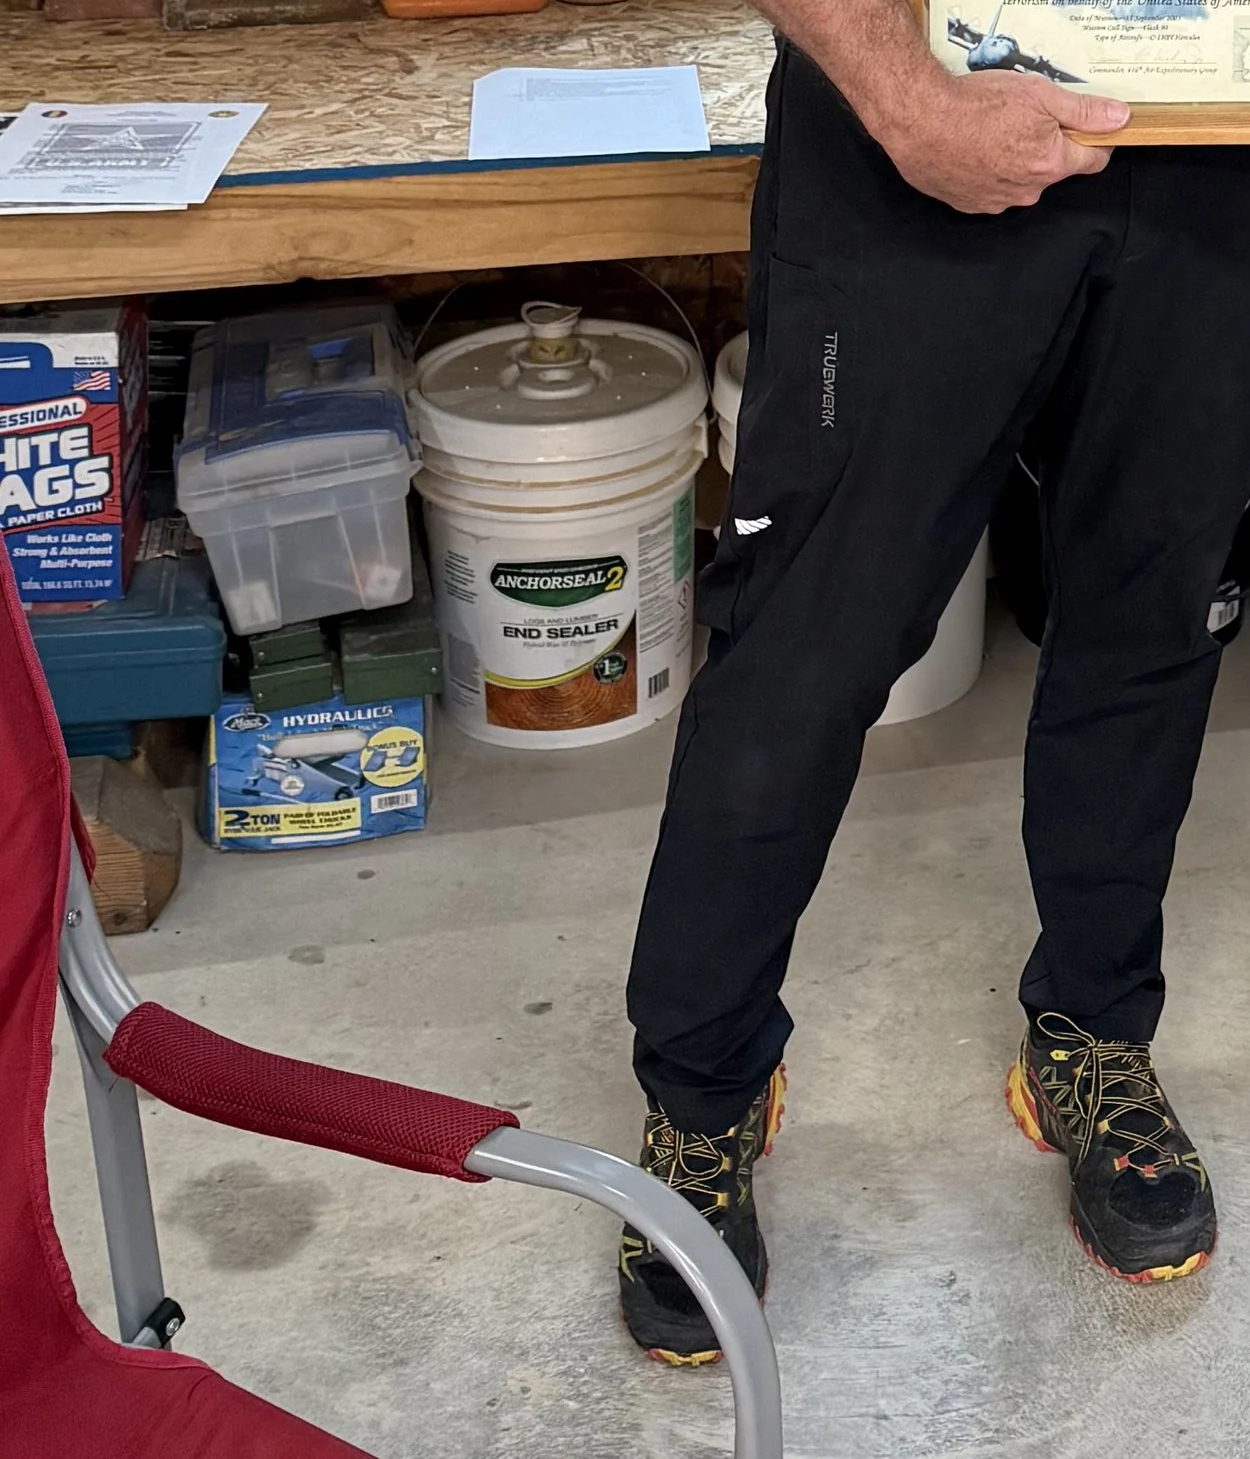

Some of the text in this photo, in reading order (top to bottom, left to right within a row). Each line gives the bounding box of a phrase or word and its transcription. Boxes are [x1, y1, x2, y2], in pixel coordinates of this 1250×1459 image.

[820, 330, 839, 429] TRUEWERK
[7, 501, 103, 527] PAPER CLOTH
[26, 532, 112, 545] Works Like Cloth
[12, 545, 113, 559] Strong & Absorbent
[39, 558, 114, 569] Multi-Purpose
[523, 613, 600, 625] LOGS AND LUMBER
[502, 618, 620, 639] END SEALER
[223, 809, 251, 829] 2
[251, 813, 281, 825] TON
